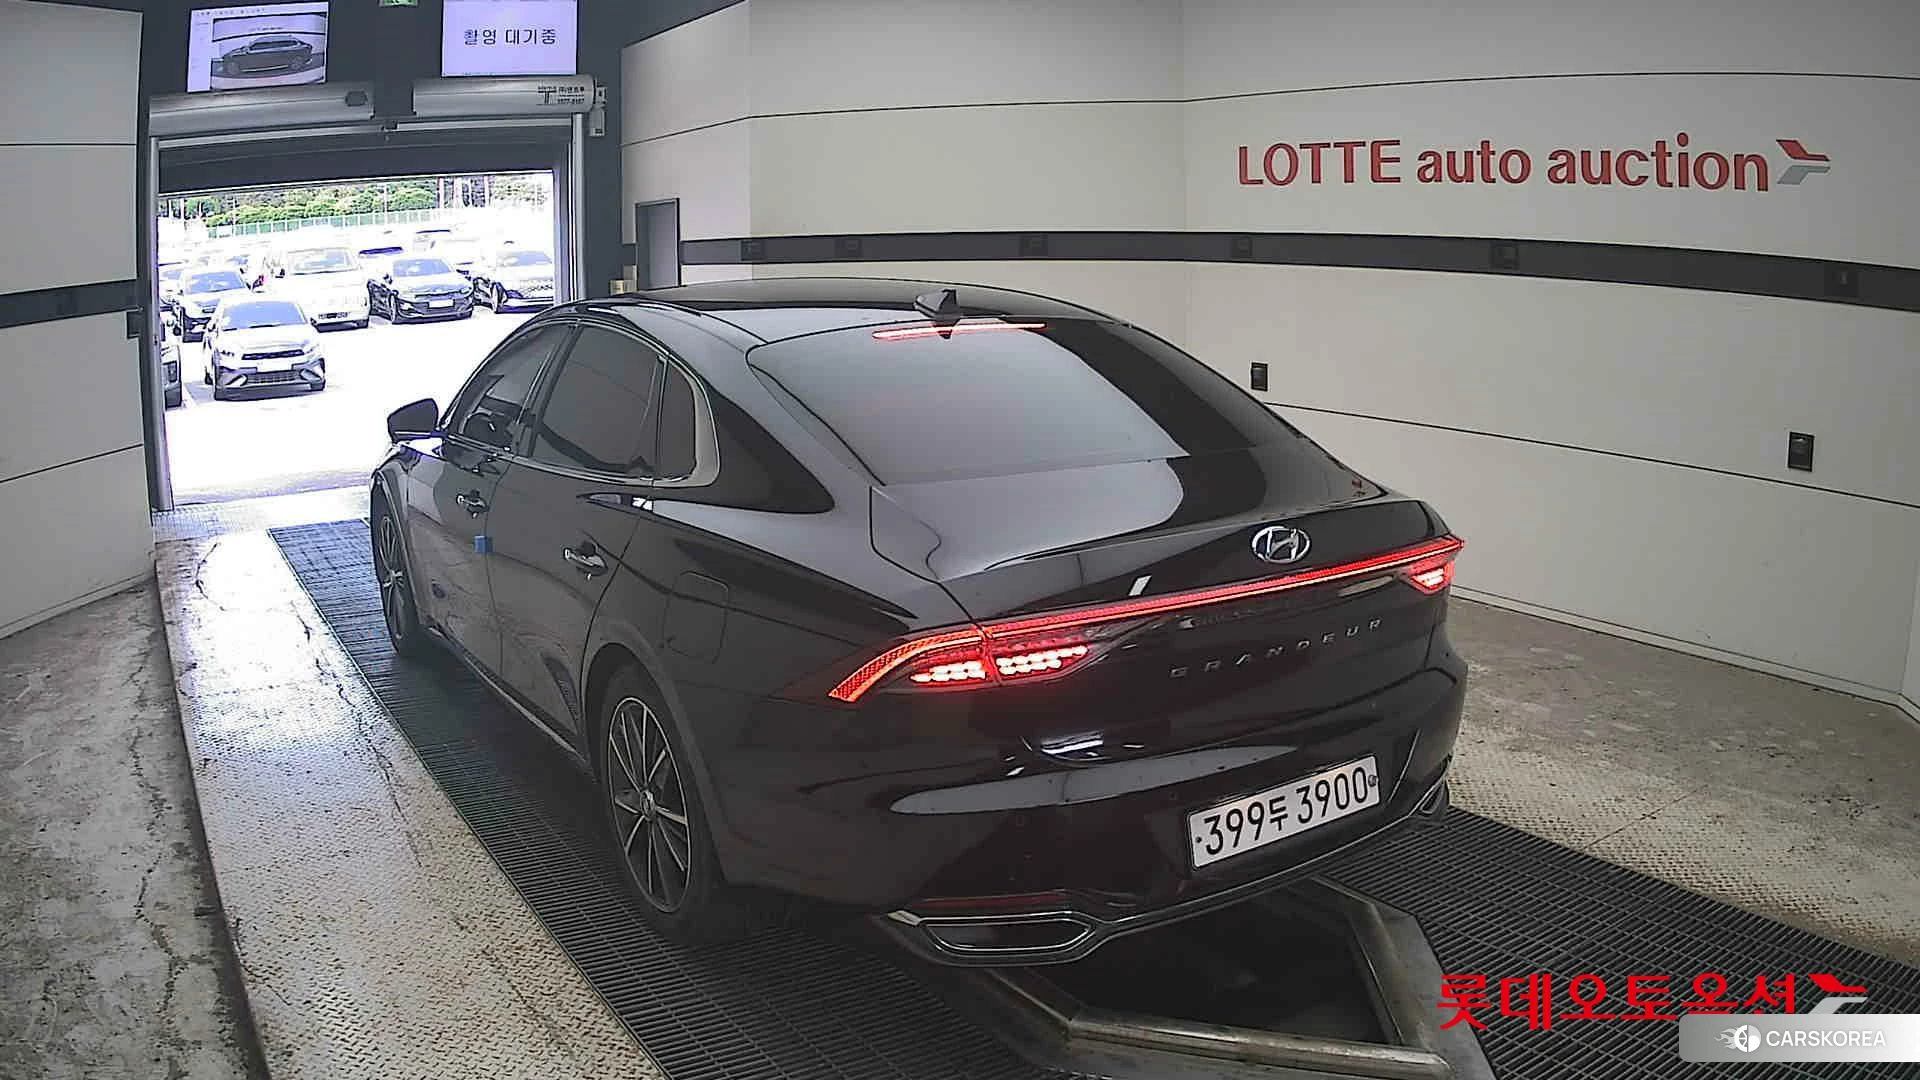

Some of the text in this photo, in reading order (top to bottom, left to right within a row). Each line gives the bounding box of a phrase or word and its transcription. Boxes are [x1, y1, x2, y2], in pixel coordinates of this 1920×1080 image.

[505, 28, 557, 46] 대기중
[1238, 133, 1770, 190] LOTTE auto auction
[1169, 617, 1383, 679] GRANDEUR
[1203, 766, 1370, 856] 399두 3900
